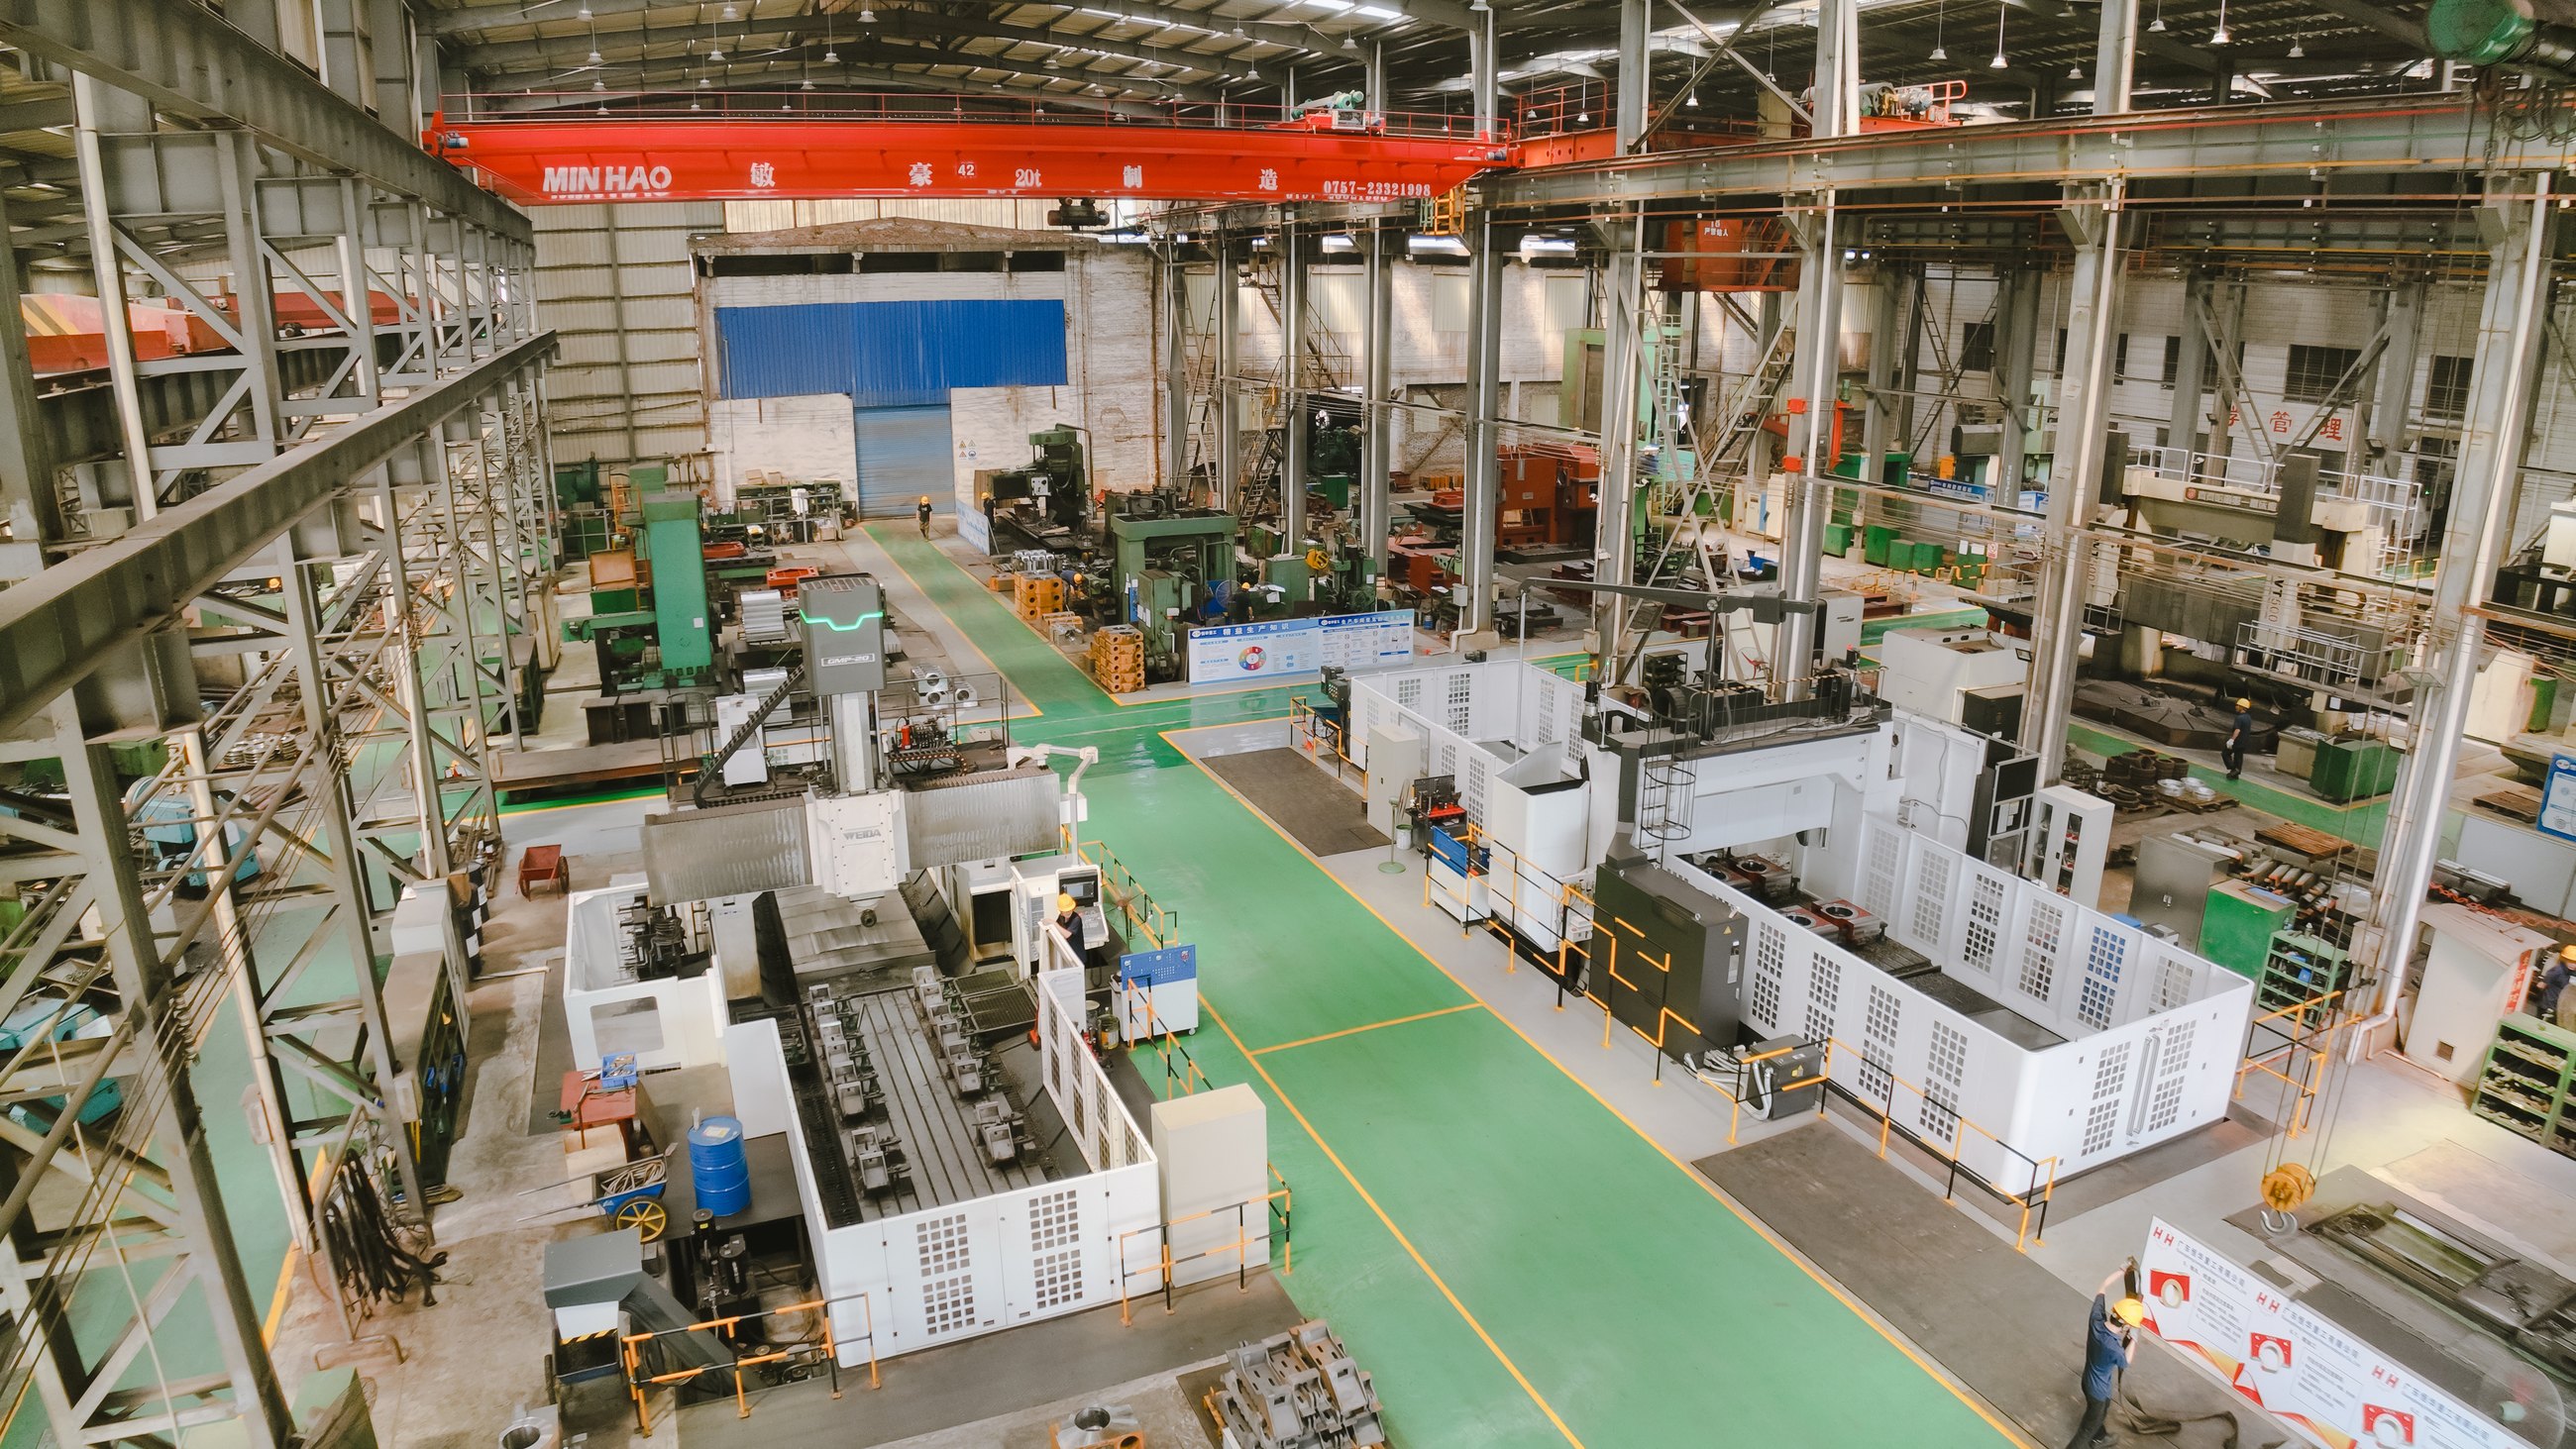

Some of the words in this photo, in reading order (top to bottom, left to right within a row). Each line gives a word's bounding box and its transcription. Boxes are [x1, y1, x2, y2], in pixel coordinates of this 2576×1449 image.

[542, 166, 599, 192] MIN
[604, 165, 673, 191] HAO
[750, 161, 776, 187] 敏
[909, 161, 933, 186] 豪
[957, 163, 976, 176] 42
[1015, 168, 1042, 188] 20t
[1123, 164, 1143, 189] 制
[1258, 168, 1279, 191] 造
[1323, 180, 1432, 197] 0757-23321998
